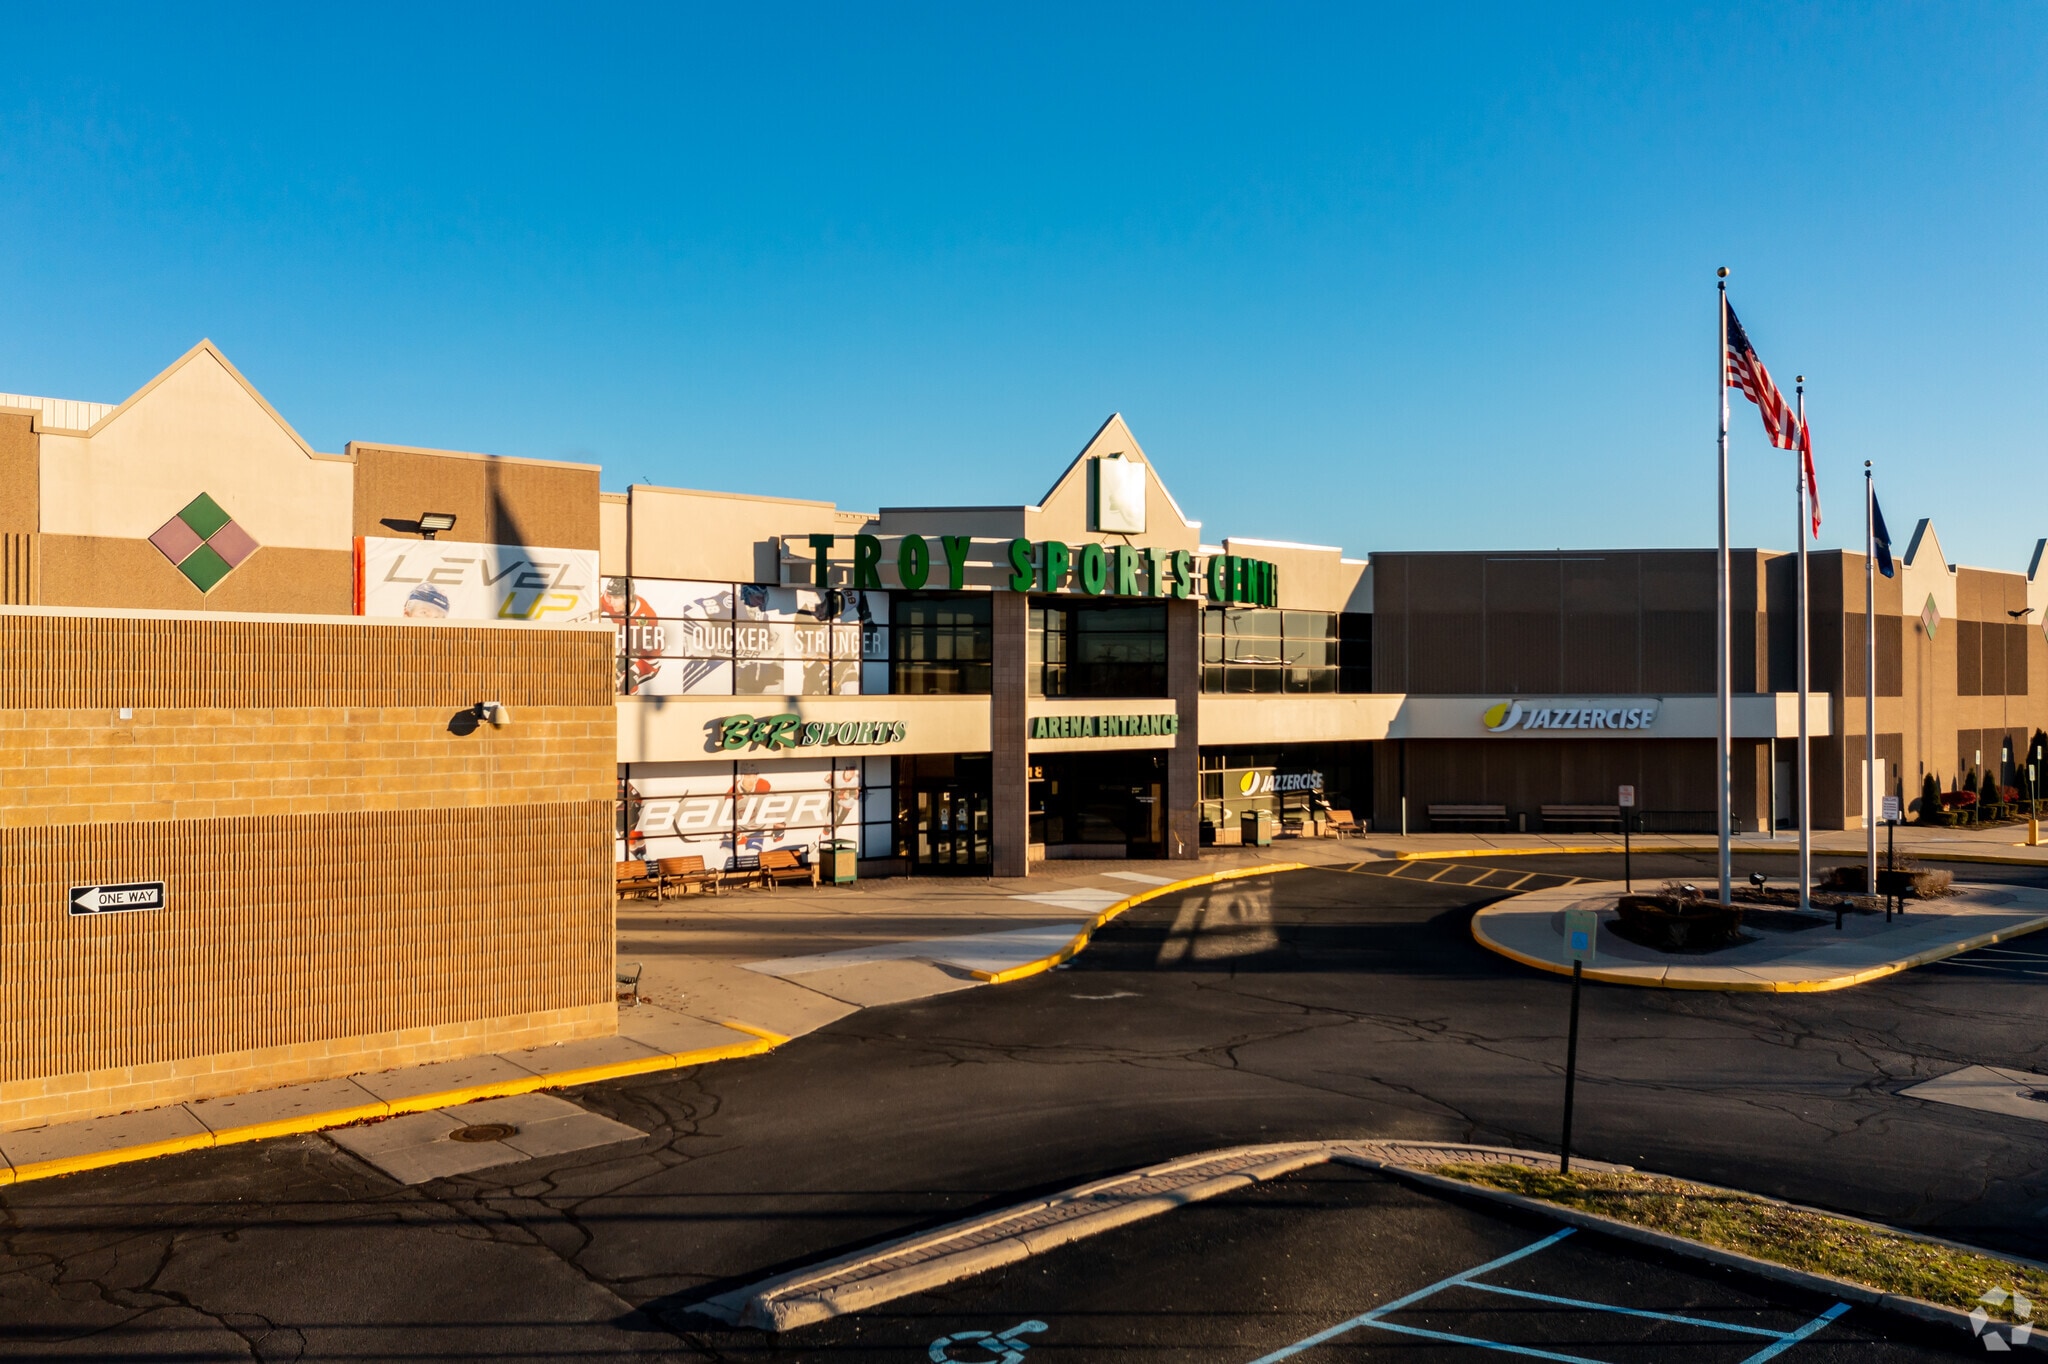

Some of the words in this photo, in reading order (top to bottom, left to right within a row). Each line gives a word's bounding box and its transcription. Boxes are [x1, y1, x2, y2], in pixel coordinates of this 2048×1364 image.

[384, 555, 585, 590] LEVEL
[809, 534, 971, 590] TROY
[1008, 538, 1191, 599] SPORTS
[497, 592, 579, 620] UP
[693, 626, 775, 651] QUICKER.
[1032, 716, 1093, 739] ARENA
[1099, 714, 1179, 737] ENTRANCE
[1522, 707, 1655, 730] JAZZERCISE
[722, 714, 801, 750] B&R
[802, 720, 908, 745] SPORTS
[1260, 773, 1323, 793] JAZZERCISE
[98, 893, 124, 905] ONE
[129, 891, 154, 903] WAY
